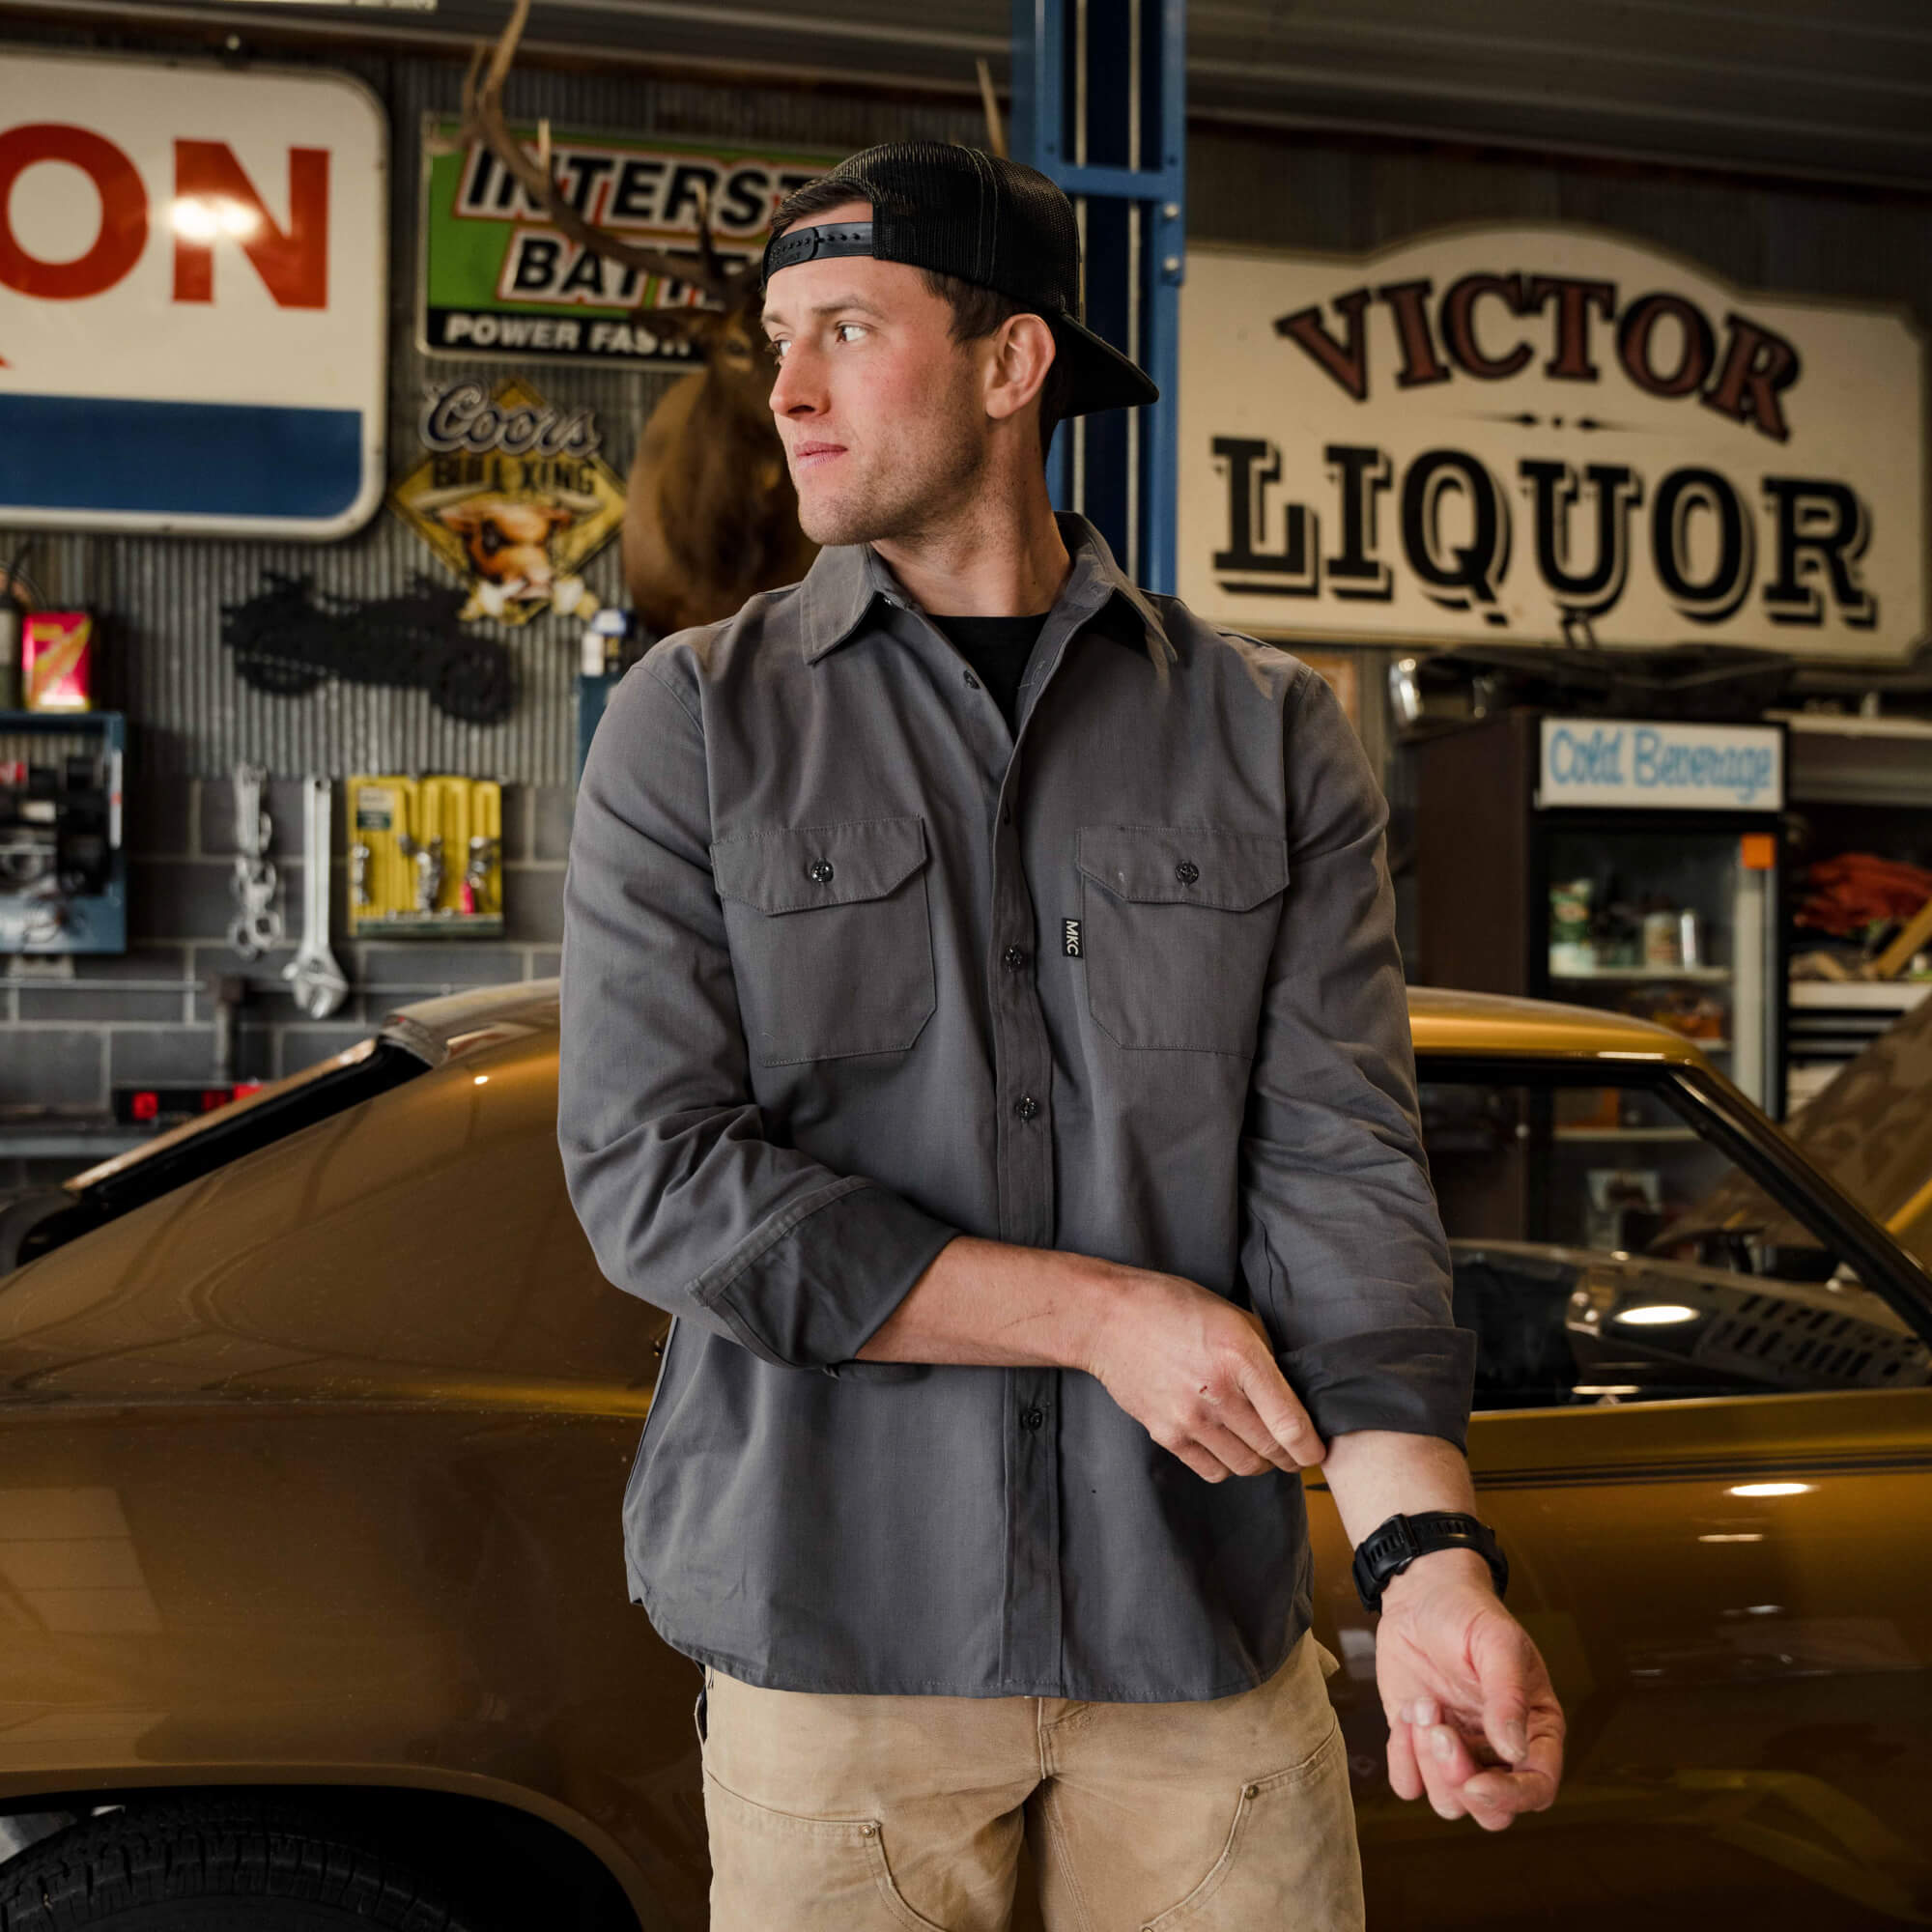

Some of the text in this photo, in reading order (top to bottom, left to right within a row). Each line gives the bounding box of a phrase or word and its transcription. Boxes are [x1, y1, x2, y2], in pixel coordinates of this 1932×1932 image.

[444, 314, 580, 350] POWER
[1273, 270, 1803, 445] VICTOR
[421, 381, 600, 457] Coors
[1210, 435, 1879, 630] LIQUOR
[1548, 727, 1775, 805] Cold Beverage
[1065, 920, 1079, 955] MKC
